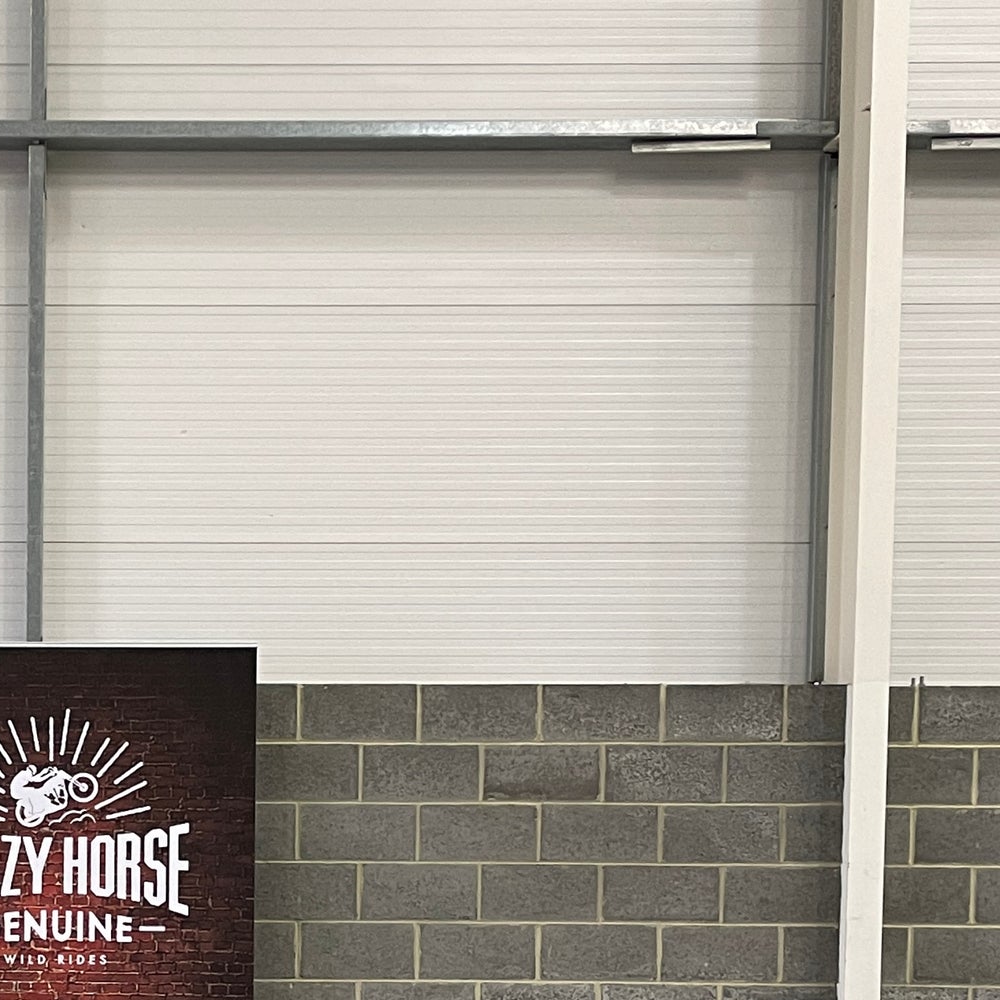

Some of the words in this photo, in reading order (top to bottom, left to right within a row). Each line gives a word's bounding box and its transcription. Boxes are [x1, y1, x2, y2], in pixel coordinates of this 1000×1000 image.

[63, 823, 190, 917] HORSE
[3, 954, 47, 965] WILD
[57, 954, 107, 966] RIDES
